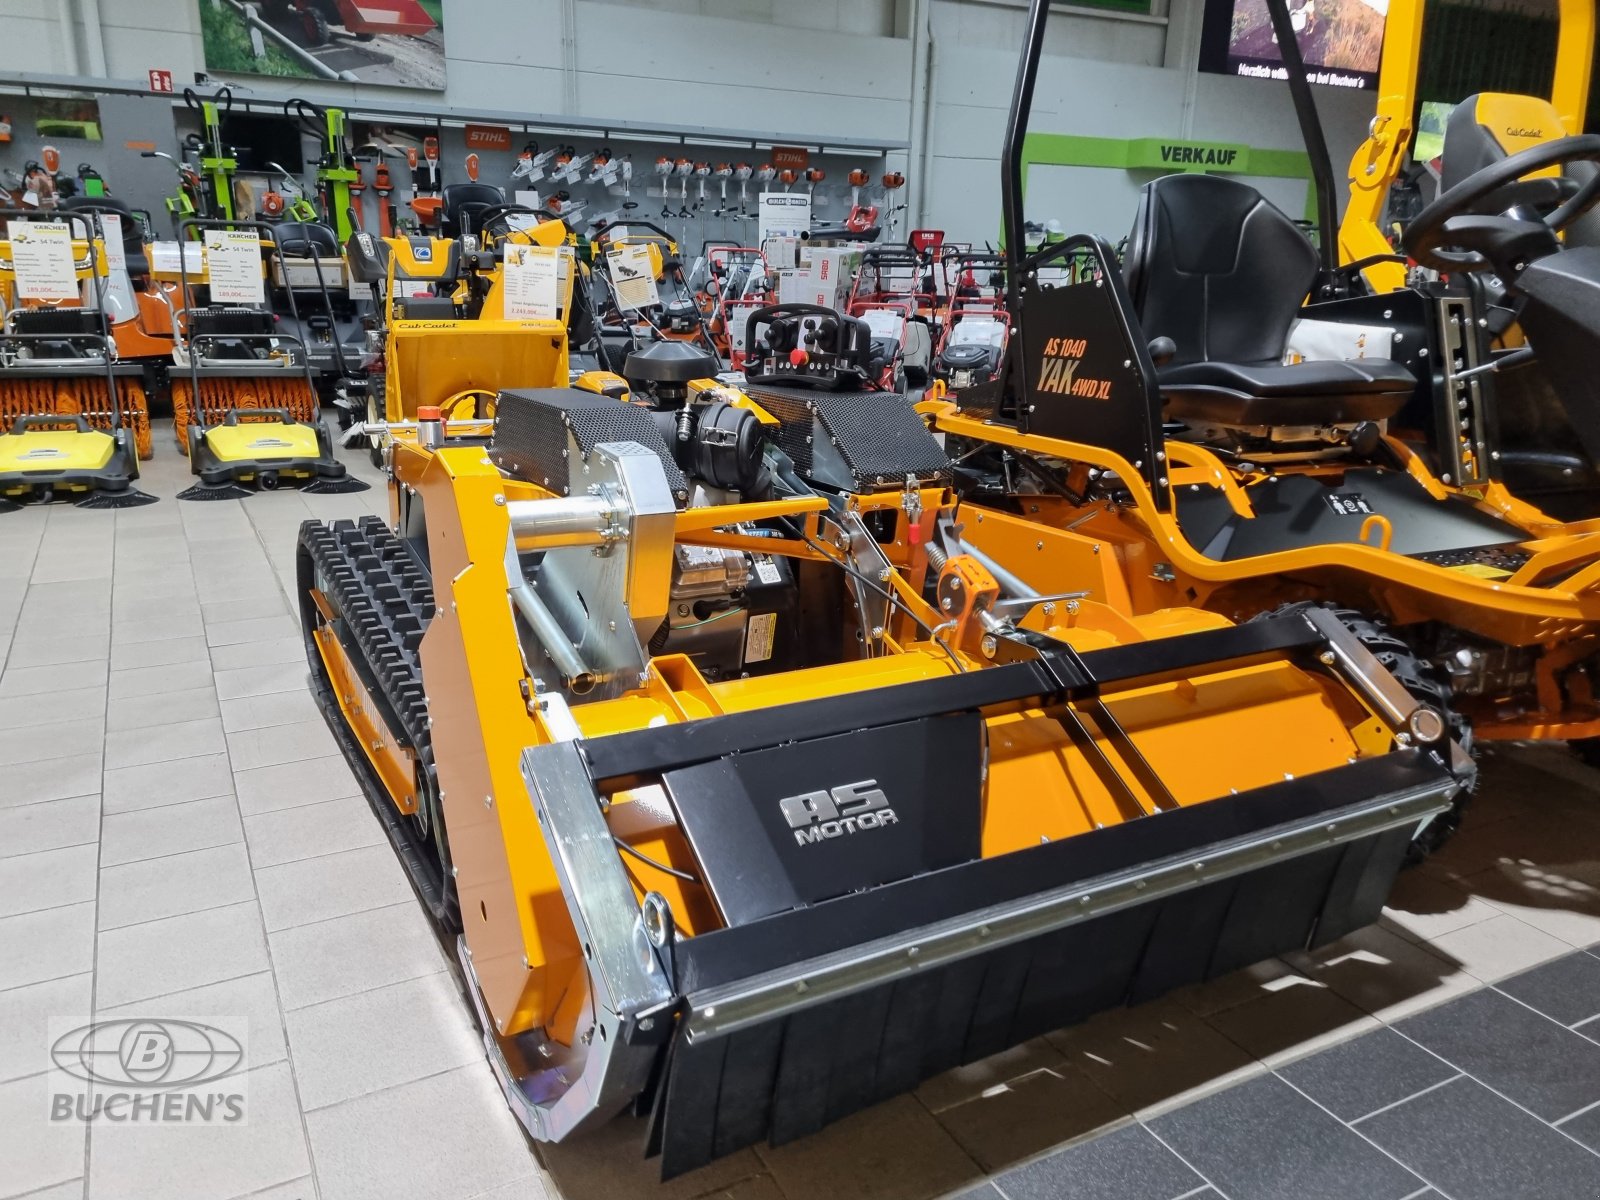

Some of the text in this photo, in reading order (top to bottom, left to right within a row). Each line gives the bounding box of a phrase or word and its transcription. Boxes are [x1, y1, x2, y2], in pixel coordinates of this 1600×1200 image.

[1238, 63, 1271, 78] Herzlich
[470, 131, 505, 143] STIHL
[776, 152, 804, 163] STIHL
[1160, 145, 1237, 165] VERKAUF
[820, 260, 829, 280] SABO
[1043, 338, 1087, 358] AS 1040
[1036, 358, 1112, 400] YAK 4WD XL
[779, 778, 890, 828] AS
[794, 808, 900, 846] MOTOR
